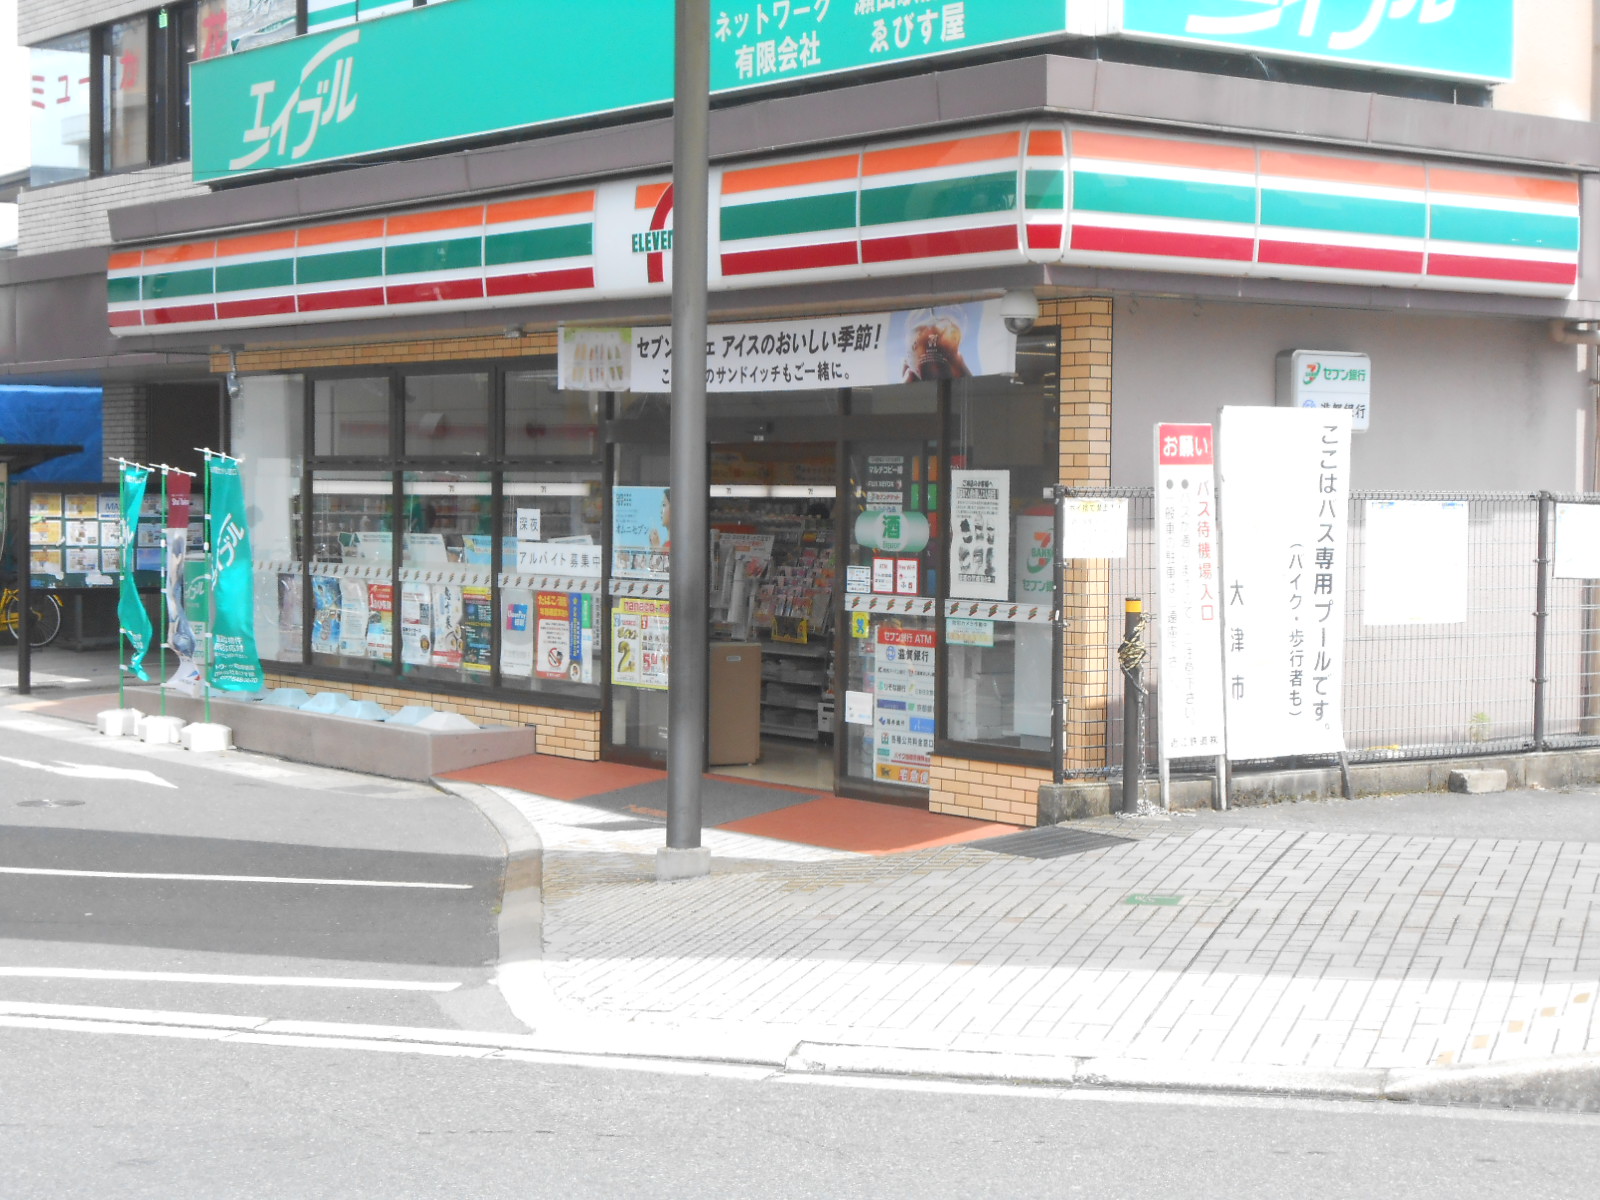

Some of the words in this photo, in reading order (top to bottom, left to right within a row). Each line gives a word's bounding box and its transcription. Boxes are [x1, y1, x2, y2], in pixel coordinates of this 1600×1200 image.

[715, 0, 830, 42] ネットワーク
[869, 2, 966, 53] ゑびす屋
[735, 31, 821, 79] 有限会社
[229, 29, 361, 171] エイブル
[1323, 367, 1366, 381] セブン銀行
[1163, 435, 1209, 457] お願い
[519, 516, 539, 532] 深夜
[882, 515, 902, 539] 酒
[519, 551, 601, 568] アルバイト募集中
[1196, 479, 1215, 621] バス待機場入口
[1312, 425, 1339, 730] ここはバス専用プールです。
[884, 631, 913, 643] セブン銀行
[914, 634, 932, 644] ATM
[1229, 580, 1245, 700] 大津市
[897, 648, 929, 662] 滋賀銀行
